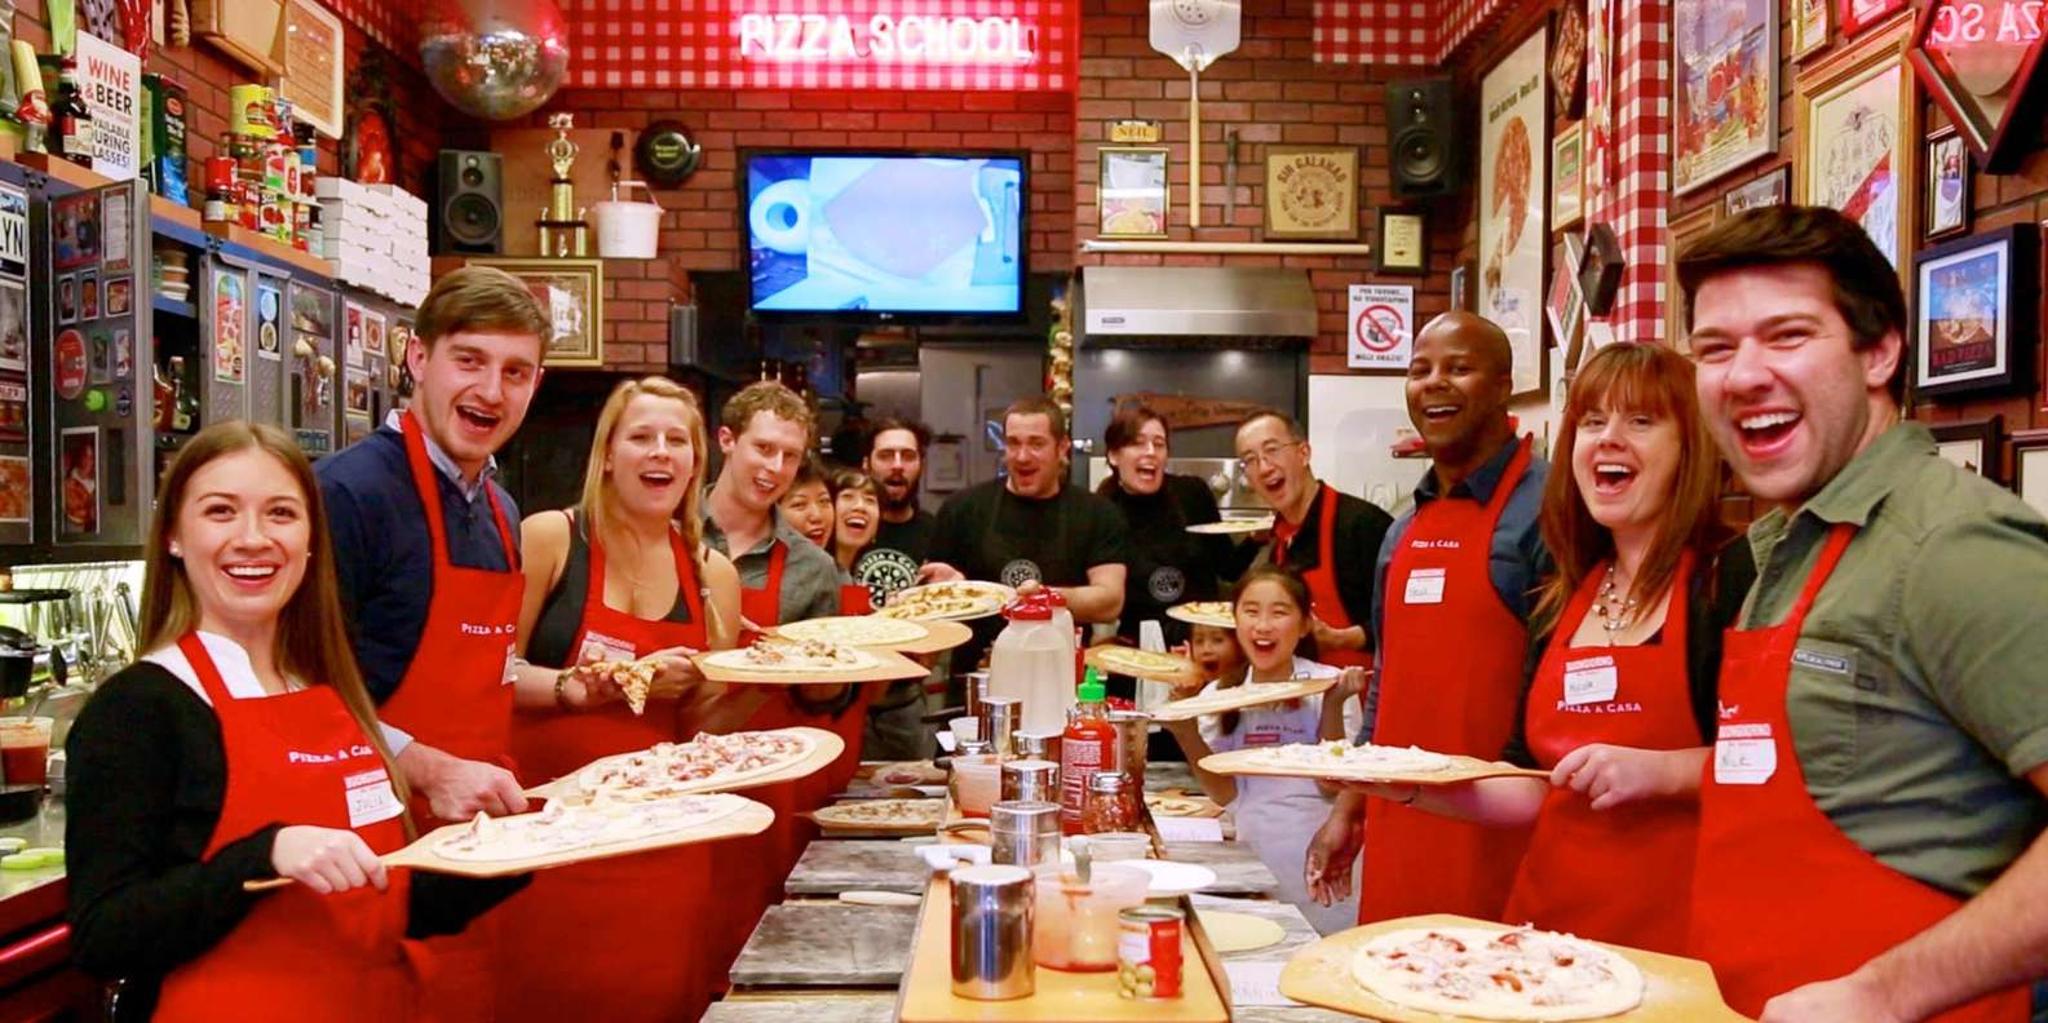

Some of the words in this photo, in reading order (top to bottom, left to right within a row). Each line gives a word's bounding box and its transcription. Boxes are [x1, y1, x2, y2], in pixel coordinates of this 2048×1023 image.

[740, 14, 851, 57] PIZZA
[868, 14, 1034, 60] SCHOOL
[88, 56, 131, 92] WINE
[96, 84, 133, 116] BEER
[93, 117, 131, 139] VAILABLE
[1117, 127, 1152, 138] NEIL
[95, 129, 131, 155] URING
[92, 145, 130, 168] LASSES!
[1436, 540, 1460, 549] CASA
[461, 623, 491, 635] PIZZA
[1606, 702, 1642, 714] CASA
